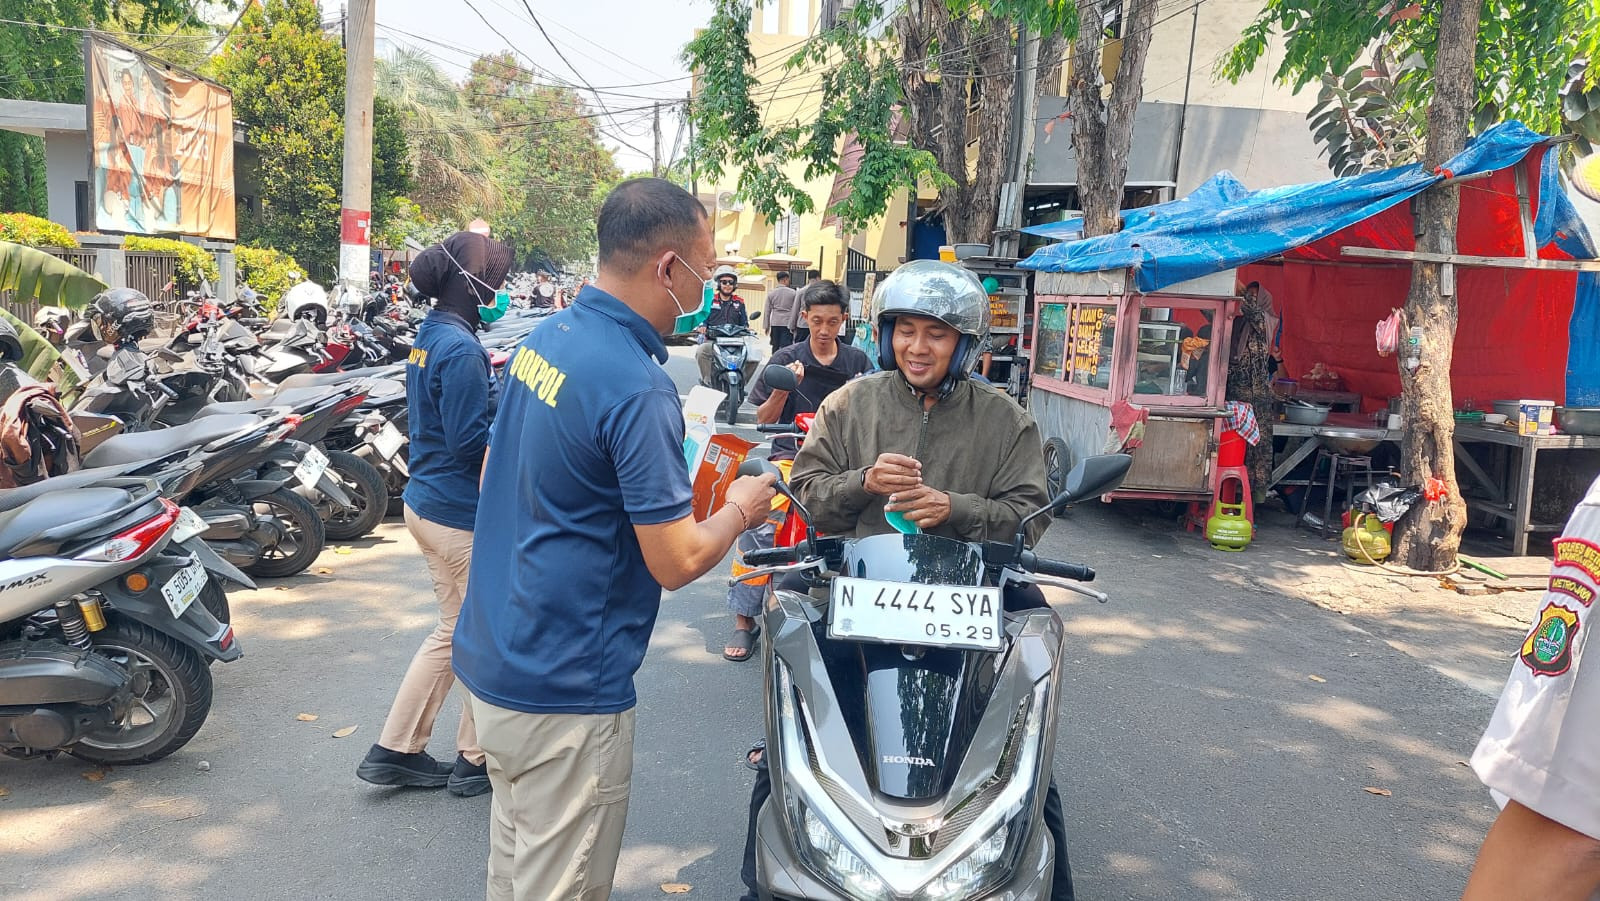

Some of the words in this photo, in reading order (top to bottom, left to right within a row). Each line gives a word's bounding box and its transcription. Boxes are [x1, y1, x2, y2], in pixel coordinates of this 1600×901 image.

[1091, 308, 1104, 375] GORENG
[165, 588, 174, 602] B
[173, 569, 193, 594] 5051
[842, 585, 854, 607] N
[874, 587, 936, 613] 4444
[950, 592, 993, 617] SYA
[882, 755, 936, 767] HONDA
